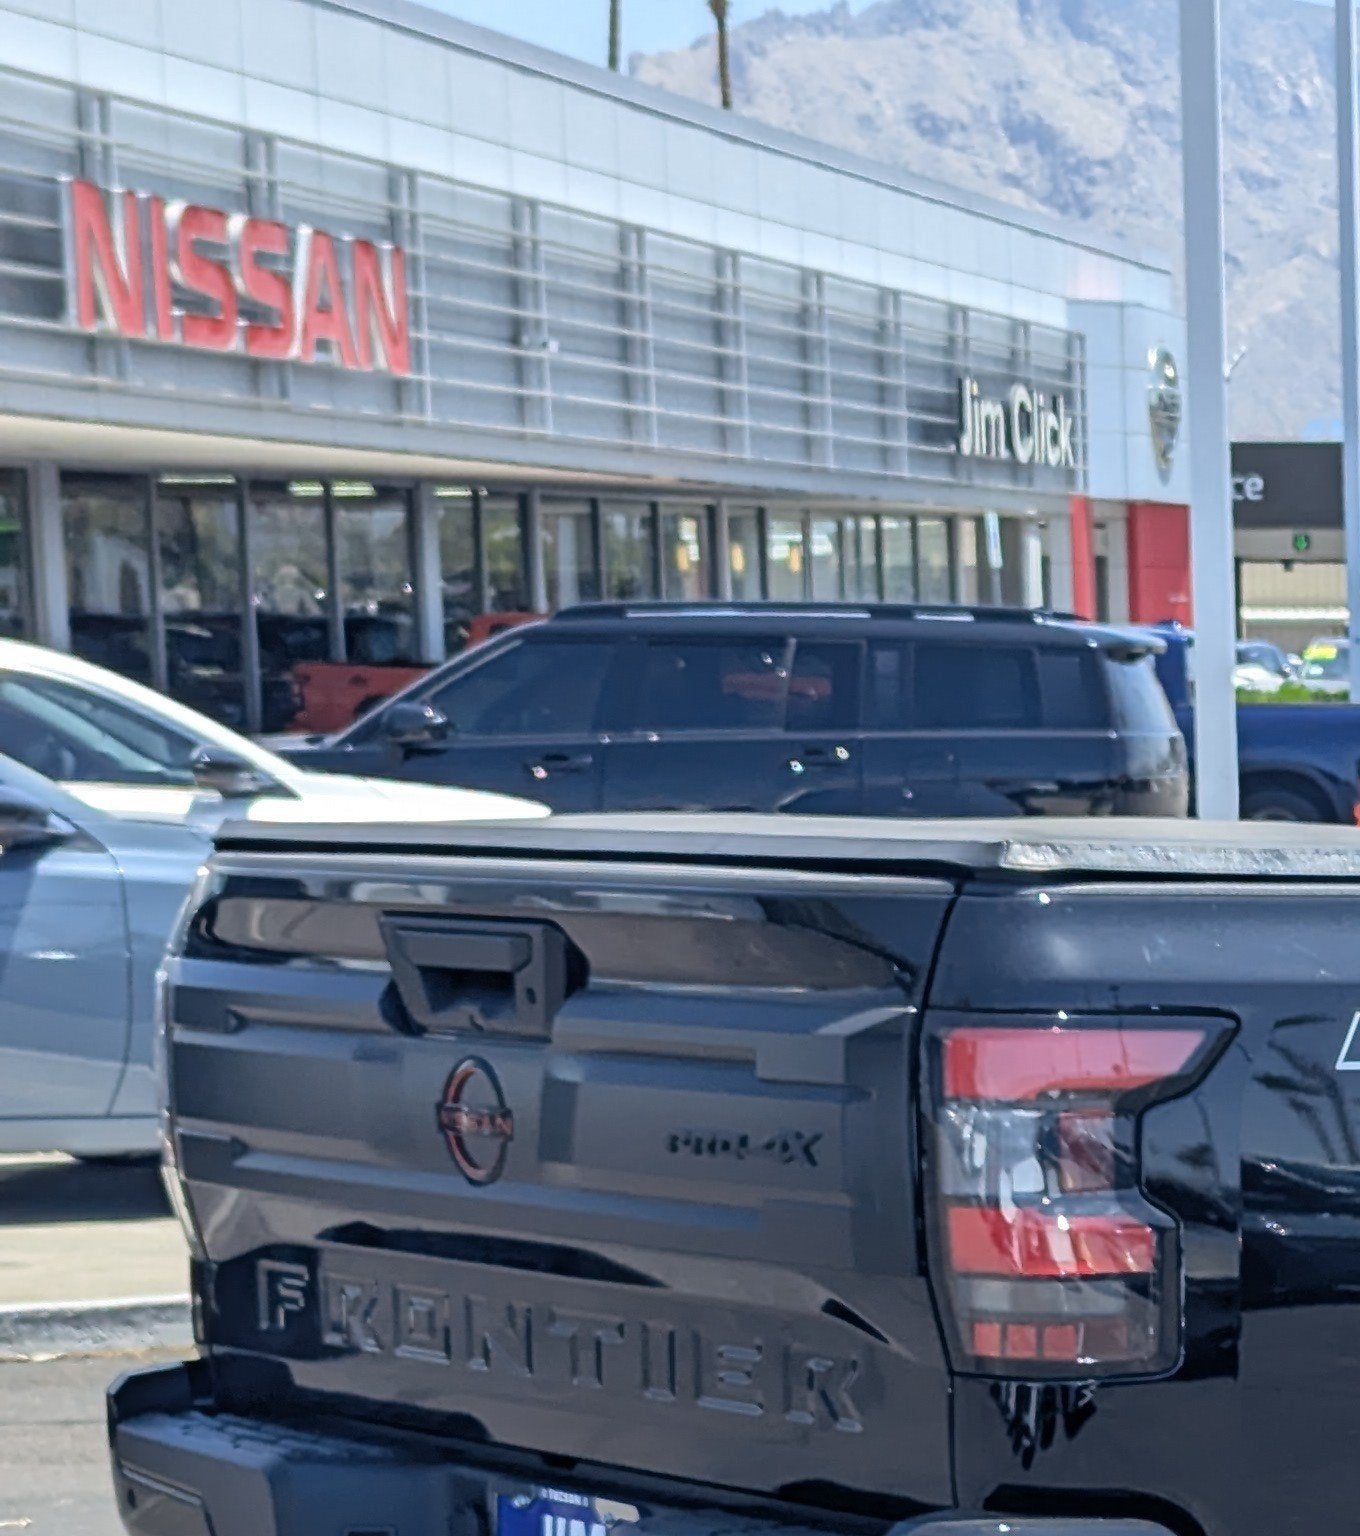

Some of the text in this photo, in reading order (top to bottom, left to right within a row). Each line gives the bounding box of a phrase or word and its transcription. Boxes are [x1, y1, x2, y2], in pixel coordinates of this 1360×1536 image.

[68, 178, 411, 376] NISSAN
[959, 376, 1010, 460] Jim
[1010, 382, 1074, 468] Click
[257, 1258, 863, 1433] FRONTIER
